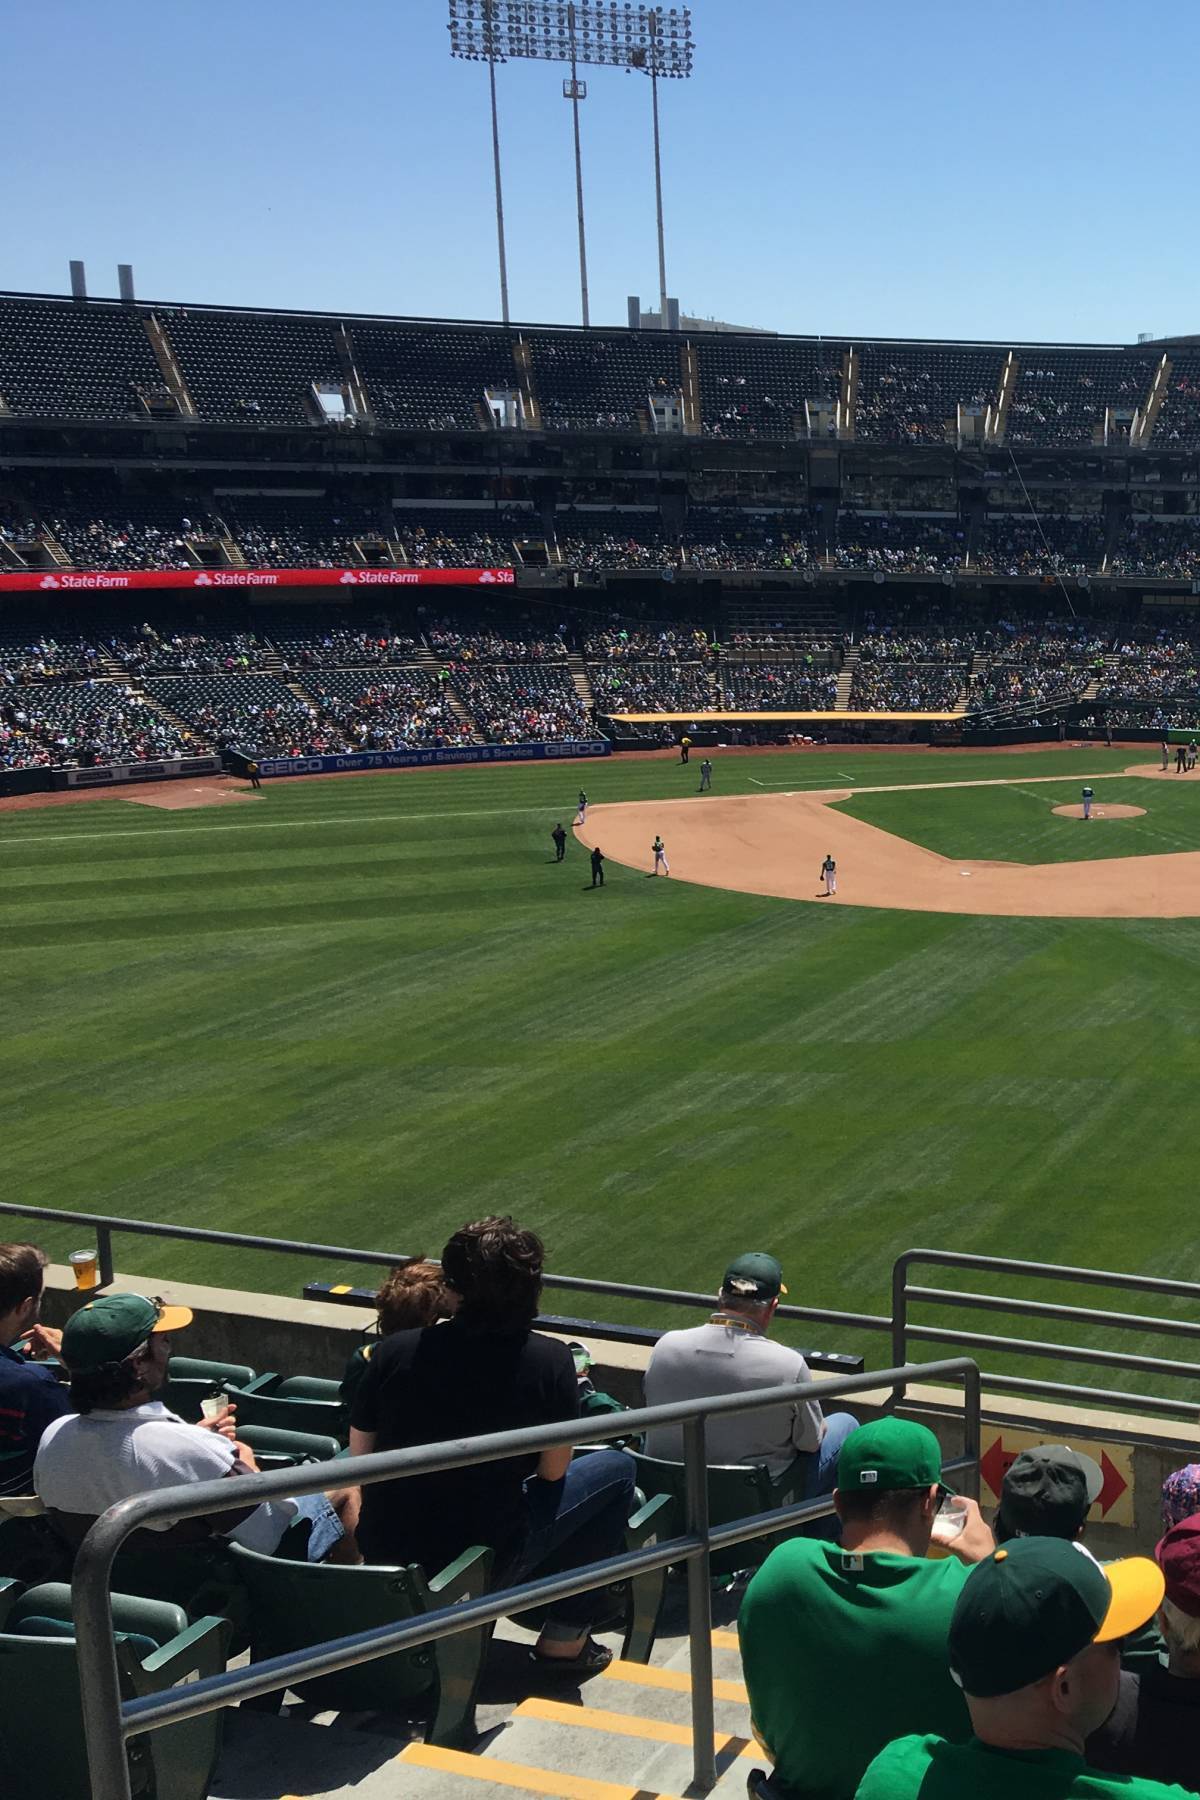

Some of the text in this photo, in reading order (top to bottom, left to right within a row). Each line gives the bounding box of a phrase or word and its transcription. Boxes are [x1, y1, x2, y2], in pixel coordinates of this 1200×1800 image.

[260, 759, 323, 776] GEICO
[336, 758, 363, 768] Over
[367, 755, 383, 766] 75
[386, 754, 418, 764] Years
[422, 752, 432, 761] of
[436, 750, 478, 761] Savings
[494, 748, 534, 757] Service
[544, 743, 605, 756] GEICO
